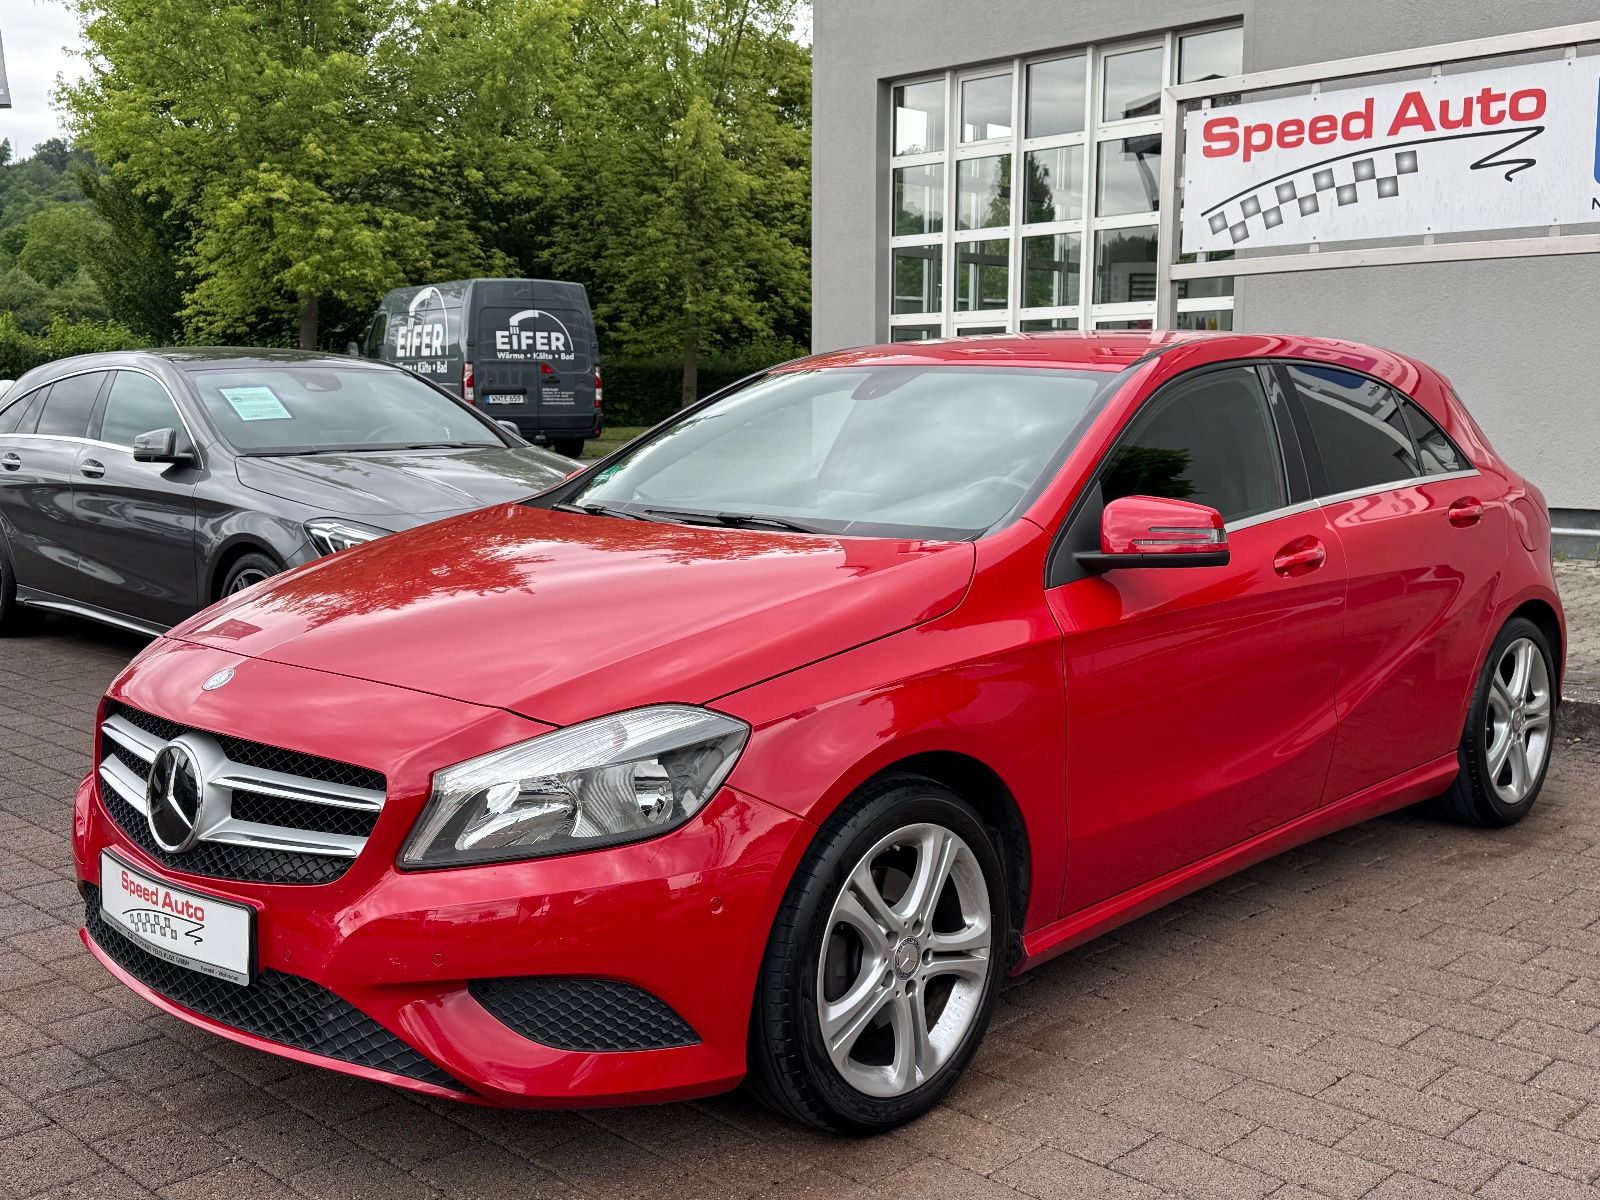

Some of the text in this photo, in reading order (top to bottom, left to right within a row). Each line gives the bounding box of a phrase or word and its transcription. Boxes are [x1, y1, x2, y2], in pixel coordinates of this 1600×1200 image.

[1202, 87, 1547, 163] Speed Auto
[436, 360, 448, 373] Bad
[497, 351, 575, 360] Wärme Kälte Bad
[121, 870, 205, 922] Speed Auto
